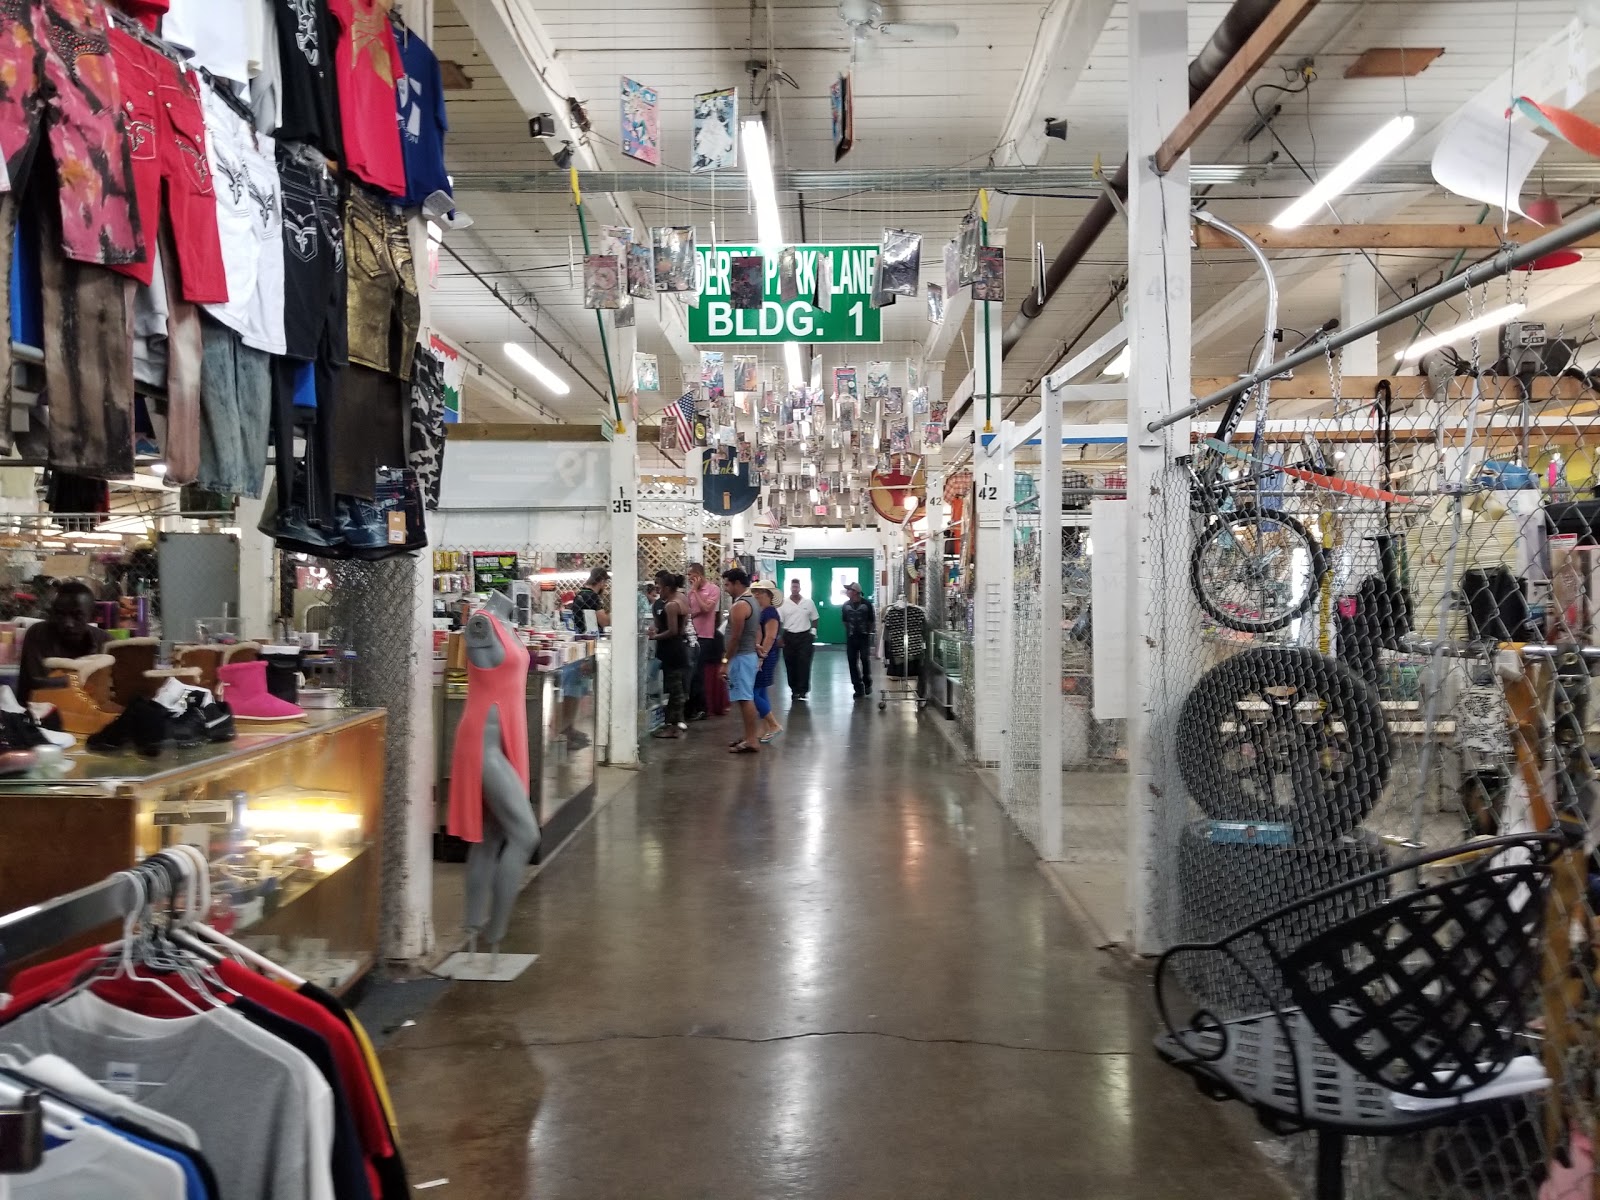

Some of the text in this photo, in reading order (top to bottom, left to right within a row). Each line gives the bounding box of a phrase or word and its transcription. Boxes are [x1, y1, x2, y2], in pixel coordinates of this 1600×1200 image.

[695, 250, 877, 295] DER PRK LANE
[708, 301, 863, 336] BLDG. 1
[978, 487, 997, 500] 42
[613, 499, 631, 513] 35
[929, 497, 942, 506] 42
[687, 507, 699, 516] 35
